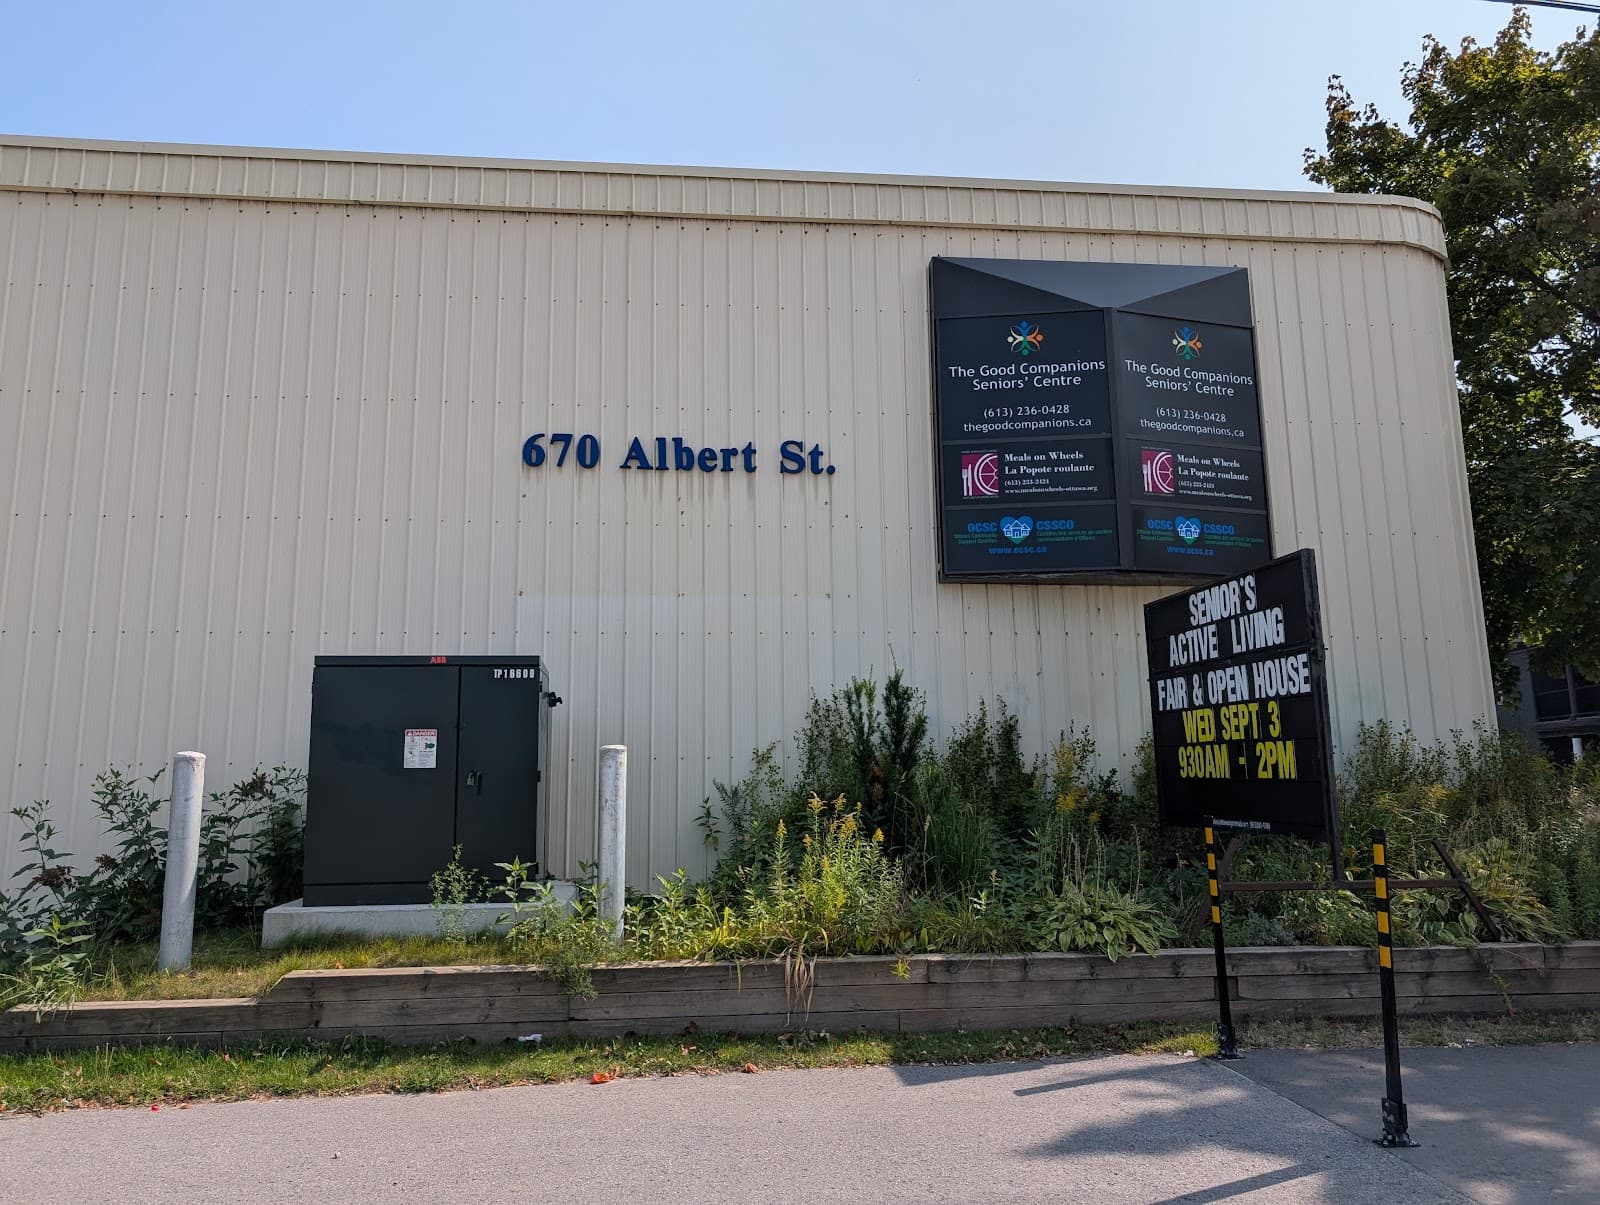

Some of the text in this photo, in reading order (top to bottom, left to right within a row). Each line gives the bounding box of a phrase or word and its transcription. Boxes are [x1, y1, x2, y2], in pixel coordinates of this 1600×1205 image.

[949, 360, 1106, 378] The Good Companions
[1125, 359, 1253, 385] The Good Companions
[973, 376, 1082, 391] Seniors' Centre
[1145, 376, 1235, 396] Seniors' Centre
[984, 404, 1070, 419] (613) 236-0428
[1156, 407, 1226, 423] (613) 236-0428
[964, 418, 1092, 433] thegoodcompanions.ca
[1140, 418, 1245, 437] thegoodcompanions.ca
[522, 433, 836, 475] 670 Albert St.
[1004, 450, 1084, 463] Meals on Wheels
[1177, 454, 1240, 468] Meals on Wheels
[1005, 463, 1095, 476] La Popote roulante
[1178, 467, 1249, 481] La Popote roulante
[967, 519, 1075, 533] OCSC CSSCO
[1147, 519, 1235, 535] OCSC CSSCO
[1188, 574, 1257, 626] SENIOR'S
[1169, 606, 1285, 667] ACTIVE LIVING
[1157, 652, 1312, 711] FAIR & OPEN HOUSE
[1182, 700, 1281, 743] WED SEPT 3
[1178, 743, 1230, 779] 930AM
[1256, 740, 1296, 780] 2PM
